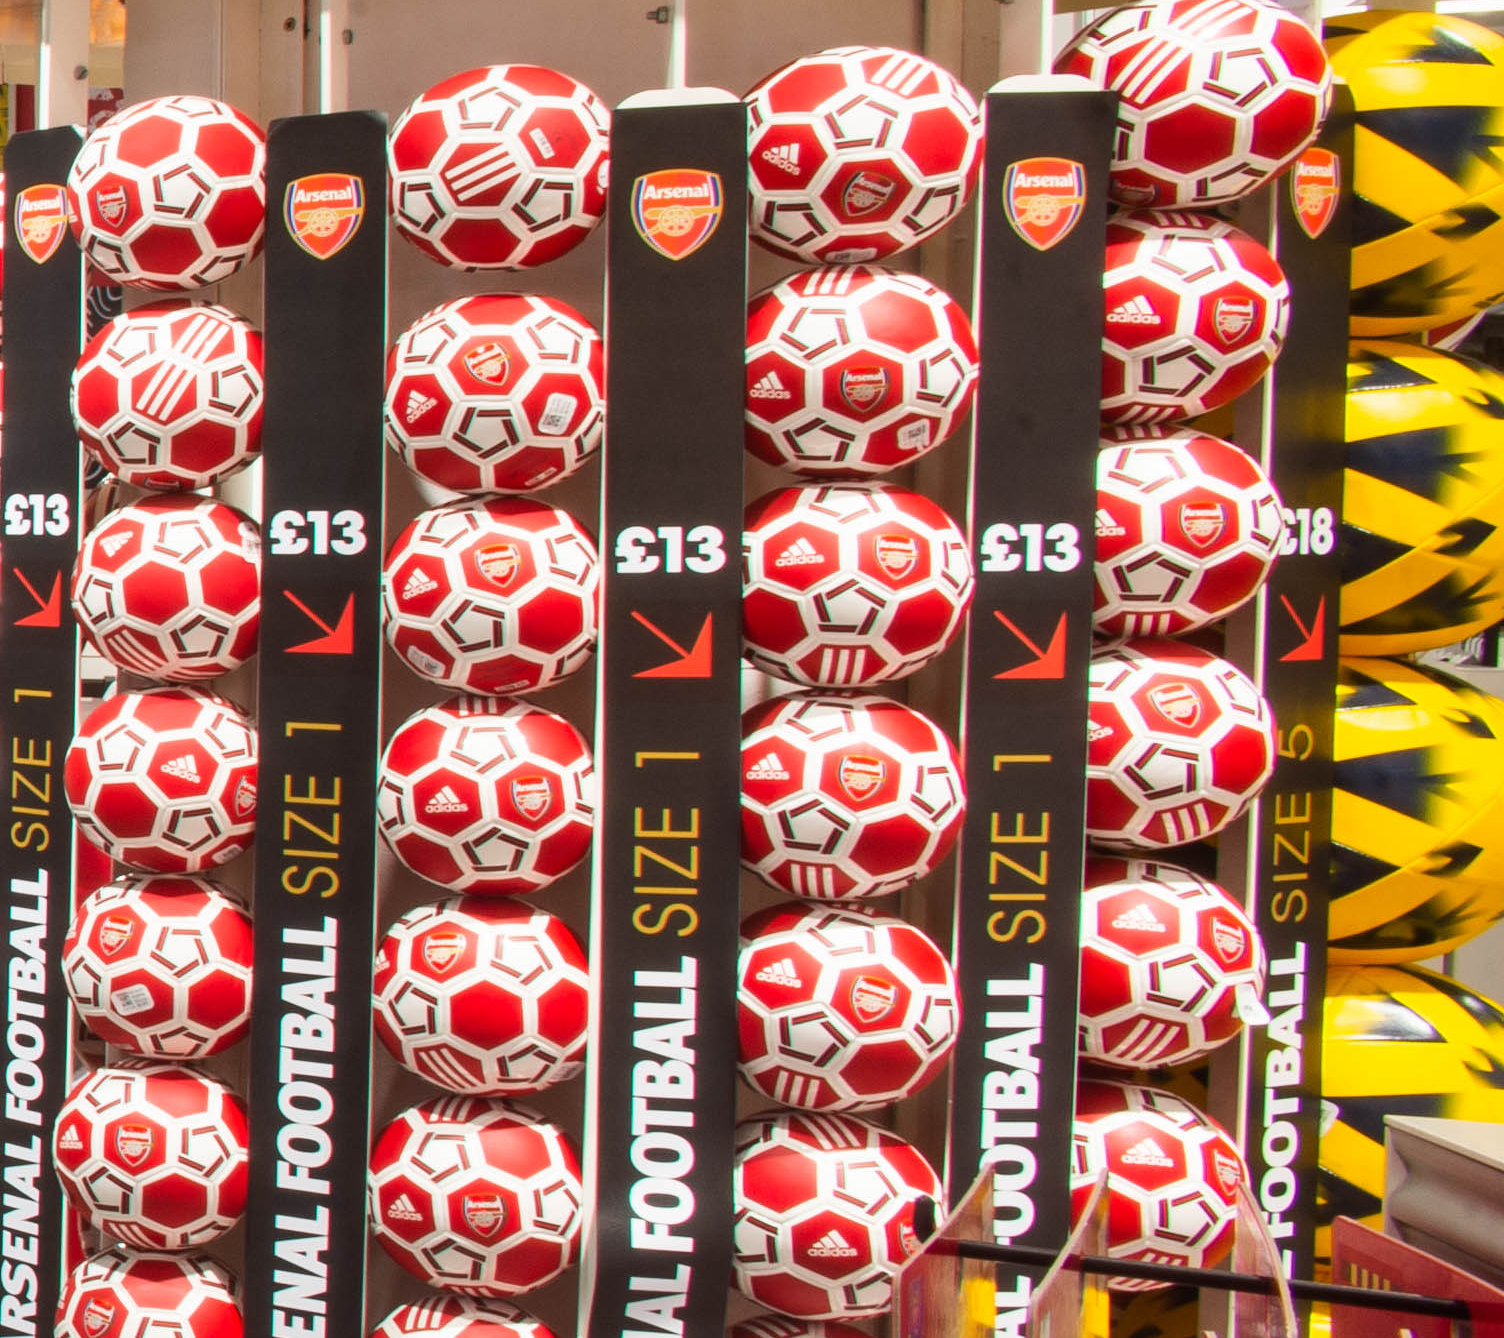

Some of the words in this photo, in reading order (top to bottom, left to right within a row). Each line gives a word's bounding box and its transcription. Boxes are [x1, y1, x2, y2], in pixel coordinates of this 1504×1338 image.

[761, 152, 801, 177] adidas
[1296, 163, 1337, 179] Arsenal
[294, 186, 353, 206] Arsenal
[643, 182, 711, 204] Arsenal
[1011, 172, 1075, 192] Arsenal
[20, 193, 64, 216] Arsenal
[1107, 311, 1161, 326] adidas
[841, 370, 885, 385] Arsenal
[748, 387, 792, 401] adidas
[4, 491, 71, 537] £13
[270, 509, 368, 556] £13
[614, 522, 727, 575] £13
[980, 522, 1082, 574] £13
[14, 686, 53, 705] 1
[286, 721, 342, 738] 1
[1279, 722, 1315, 761] 5
[636, 751, 701, 772] 1
[993, 753, 1052, 773] 1
[11, 737, 53, 852] SIZE
[424, 799, 468, 814] adidas
[282, 776, 342, 900] SIZE
[633, 804, 701, 940] SIZE
[1272, 789, 1314, 923] SIZE
[989, 812, 1051, 945] SIZE
[5, 867, 49, 1122] FOOTBALL
[276, 916, 338, 1197] FOOTBALL
[630, 955, 699, 1252] FOOTBALL
[981, 959, 1046, 1247] OOTBALL
[1259, 941, 1308, 1239] FOOTBALL
[807, 1242, 857, 1259] adidas
